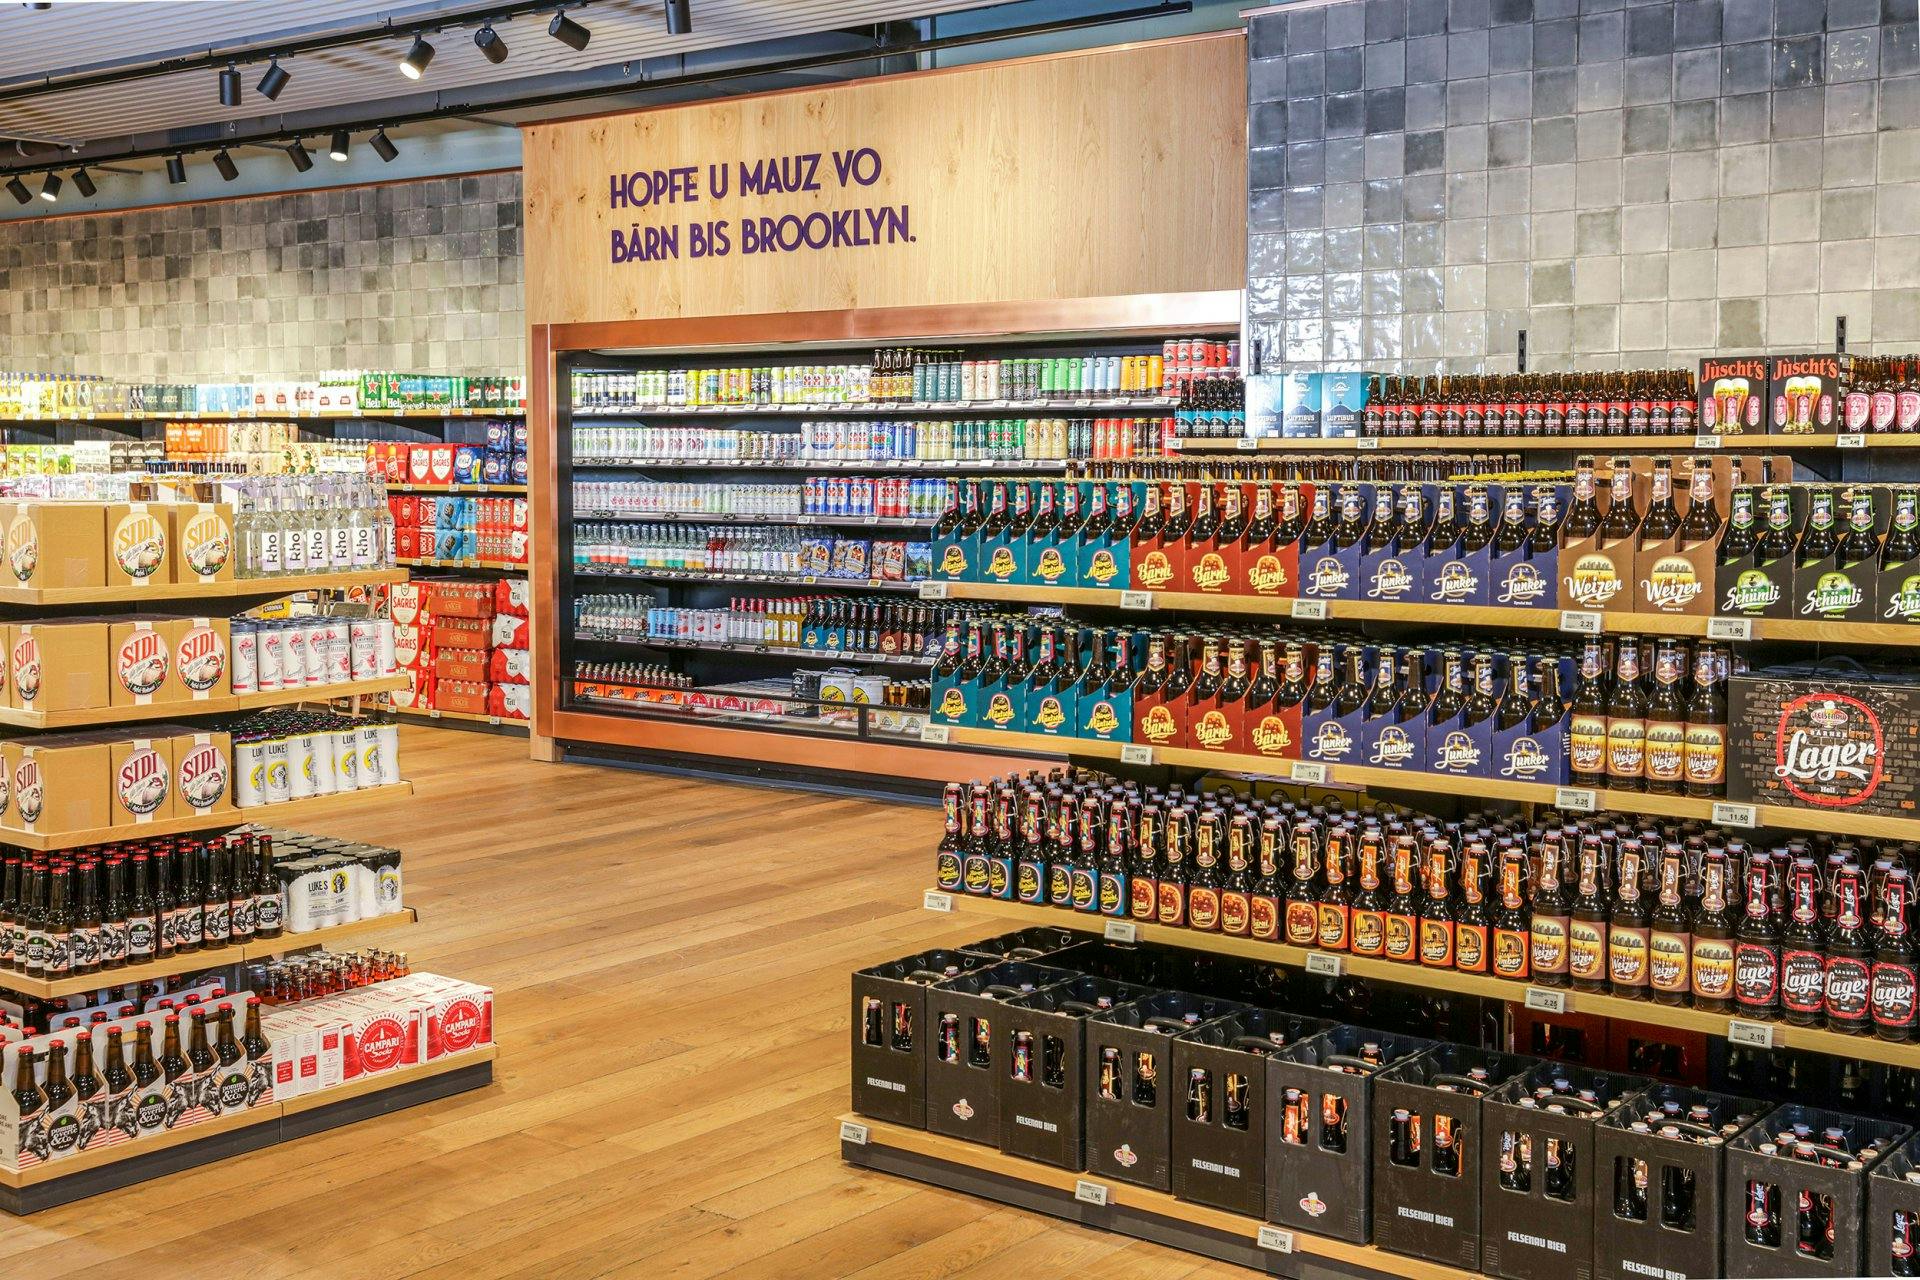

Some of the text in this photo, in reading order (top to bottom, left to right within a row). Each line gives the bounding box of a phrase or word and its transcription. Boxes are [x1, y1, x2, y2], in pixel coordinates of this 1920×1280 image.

[610, 147, 882, 209] HOPFE U MAUZ VO
[611, 205, 917, 264] BÄRN BIS BROOKLYN.
[118, 515, 155, 550] SIDI
[186, 515, 222, 549] SIDI
[335, 530, 347, 559] Rho
[356, 529, 368, 557] Rho
[267, 534, 278, 563] Rho
[290, 533, 300, 562] Rho
[312, 531, 323, 560] Rho
[1305, 572, 1349, 596] Junker
[1367, 574, 1413, 598] Junker
[1431, 576, 1478, 601] Junker
[1497, 578, 1547, 603] Junker
[1563, 576, 1622, 603] Weizen
[1640, 579, 1702, 607] Weizen
[392, 597, 417, 609] SAGRES
[1721, 585, 1781, 612] Schümli
[1801, 588, 1863, 615] Schümli
[1729, 627, 1744, 635] 1.90
[14, 639, 36, 671] SIDI
[122, 633, 159, 669] SIDI
[180, 631, 216, 667] SIDI
[1309, 735, 1352, 758] Junker
[1369, 739, 1415, 764] Junker
[1434, 745, 1481, 770] Junker
[1574, 747, 1602, 762] Weizen
[1611, 751, 1642, 767] Weizen
[1775, 729, 1878, 782] Lager
[121, 751, 158, 789] SIDI
[182, 747, 218, 784] SIDI
[1500, 751, 1550, 776] Junker
[1650, 755, 1682, 771] Weizen
[1688, 758, 1719, 774] Weizen
[16, 762, 37, 793] SIDI
[1574, 798, 1589, 806] 2.25
[1729, 812, 1749, 821] 11.50
[1533, 948, 1560, 961] Weizen
[1613, 959, 1640, 973] Weizen
[1651, 965, 1680, 979] Weizen
[1697, 969, 1729, 986] Weizen
[1736, 957, 1775, 987] Lager
[1782, 965, 1824, 993] Lager
[1826, 972, 1869, 1000] Lager
[1871, 978, 1916, 1007] Lager
[1543, 999, 1558, 1007] 2.25
[445, 1017, 476, 1034] CAMPARI
[1750, 1032, 1765, 1041] 2.10
[364, 1036, 400, 1053] CAMPARI
[866, 1076, 906, 1093] FELSENAU BIER
[1015, 1115, 1058, 1132] FELSENAU BIER
[1192, 1158, 1240, 1178] FELSENAU BIER
[1398, 1206, 1454, 1227] FELSENAU BIER
[1274, 1239, 1287, 1247] 1.95
[1507, 1231, 1567, 1253] FELSENAU BIER
[1622, 1259, 1664, 1279] FELSENAU
